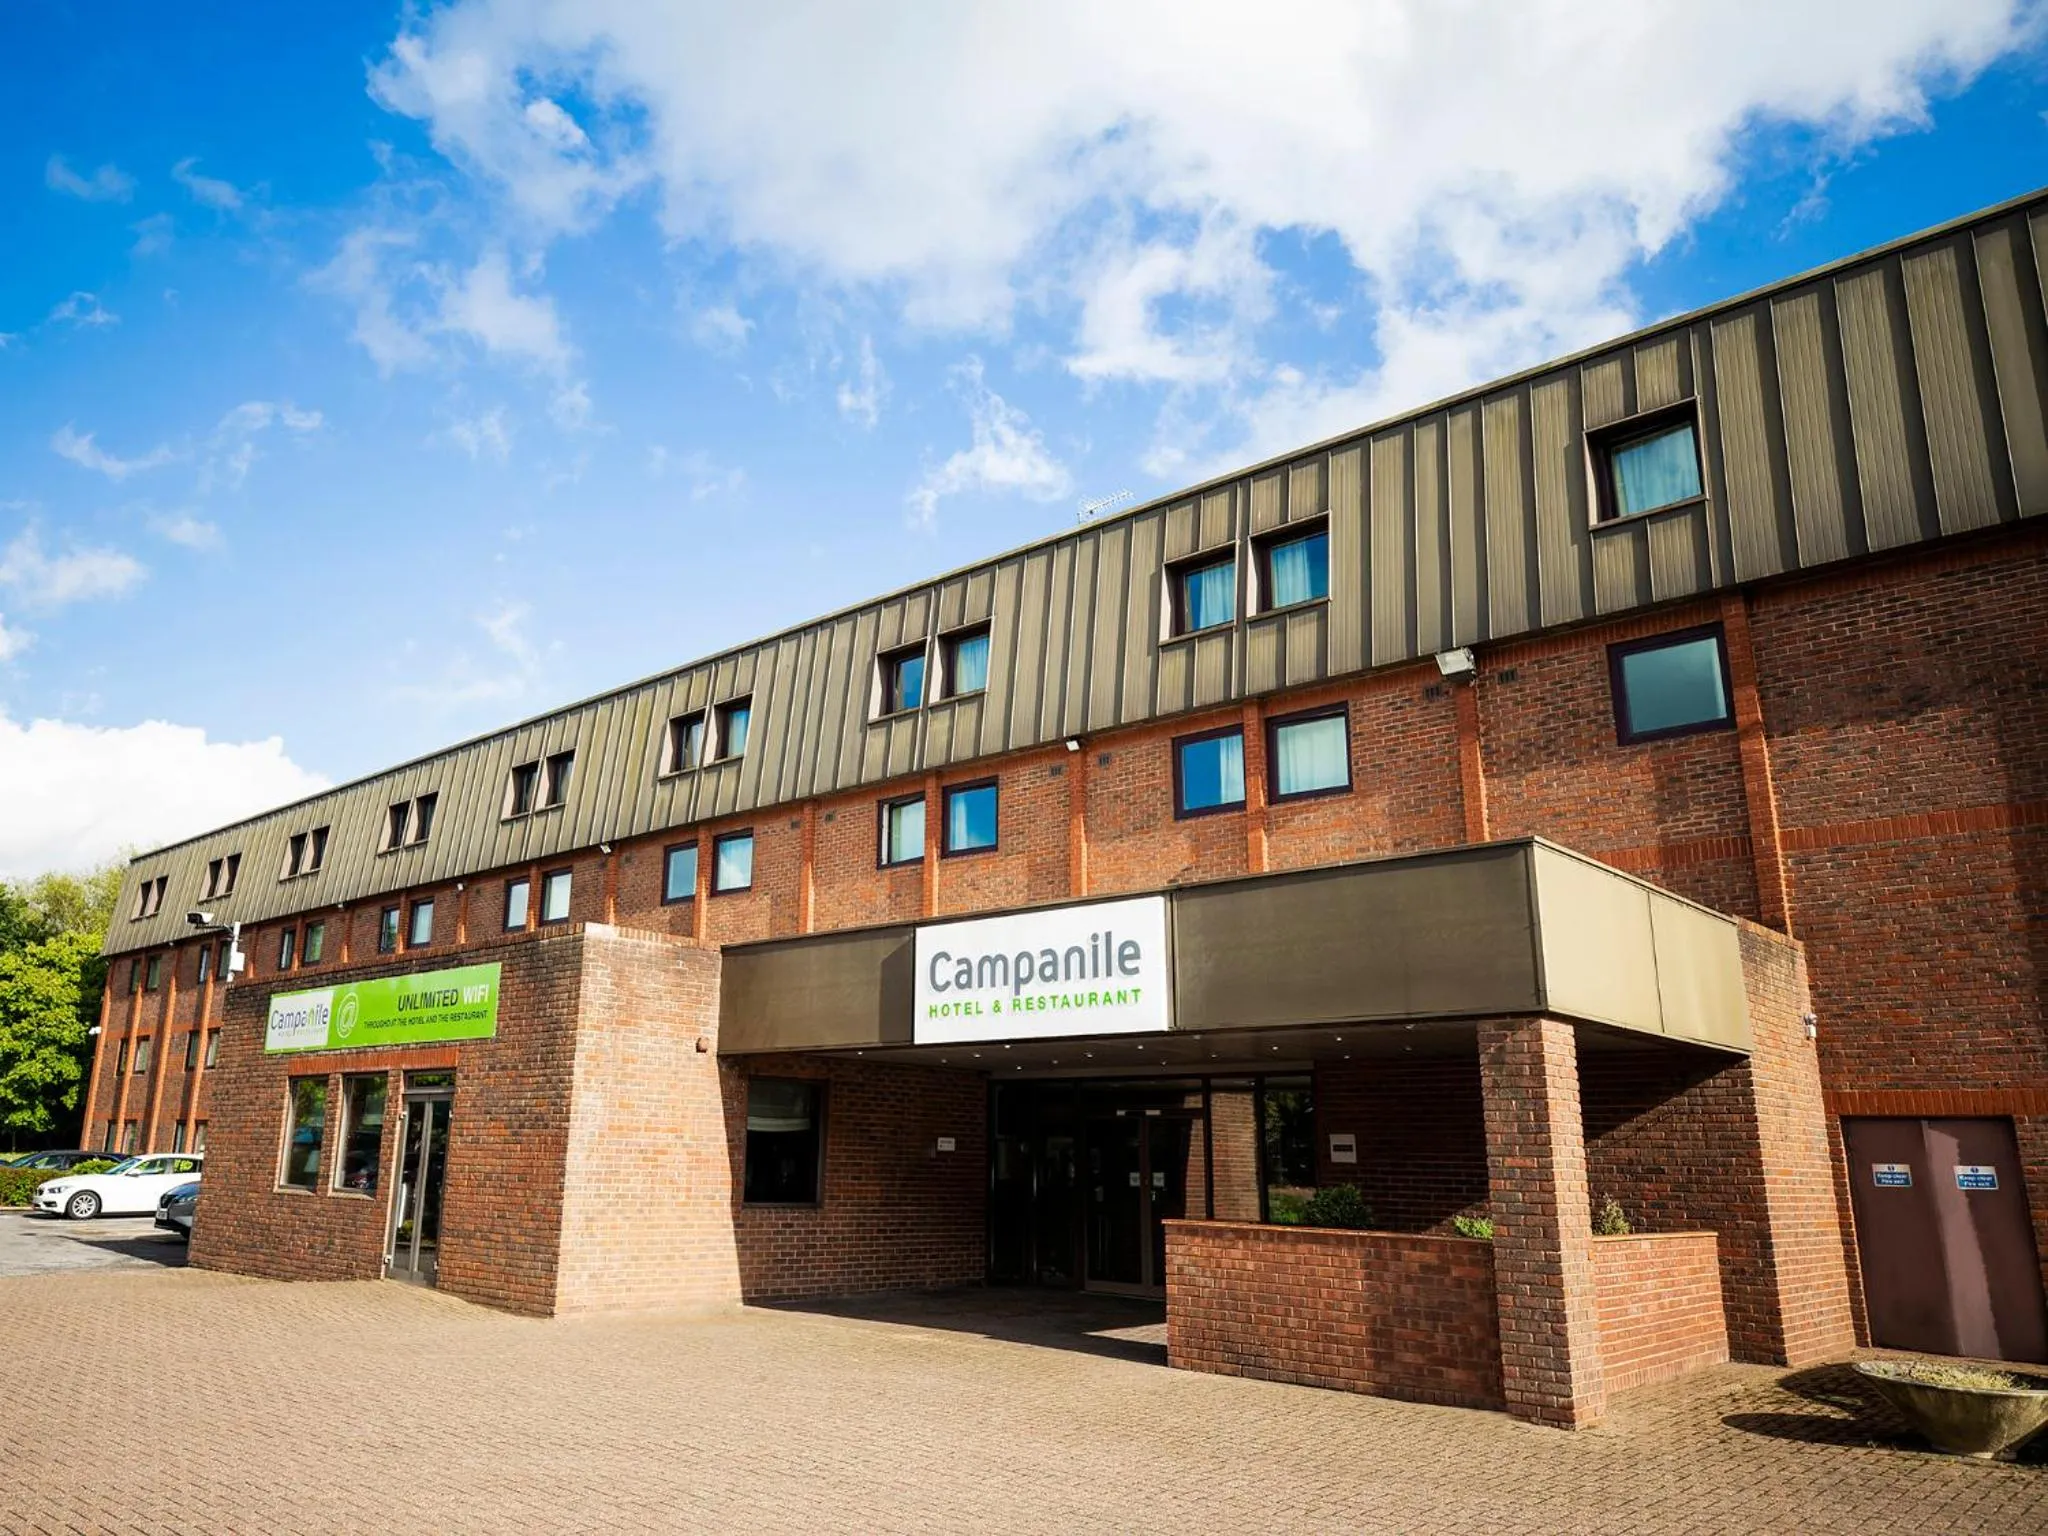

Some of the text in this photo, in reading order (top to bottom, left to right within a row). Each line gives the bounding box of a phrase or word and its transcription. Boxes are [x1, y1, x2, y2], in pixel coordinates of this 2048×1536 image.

[929, 931, 1141, 996] Campanile
[398, 984, 490, 1012] UNLIMITED WIFI
[929, 988, 1142, 1018] HOTEL & RESTAURANT
[271, 1003, 329, 1037] Campanile
[450, 1010, 488, 1022] RESTAURANT
